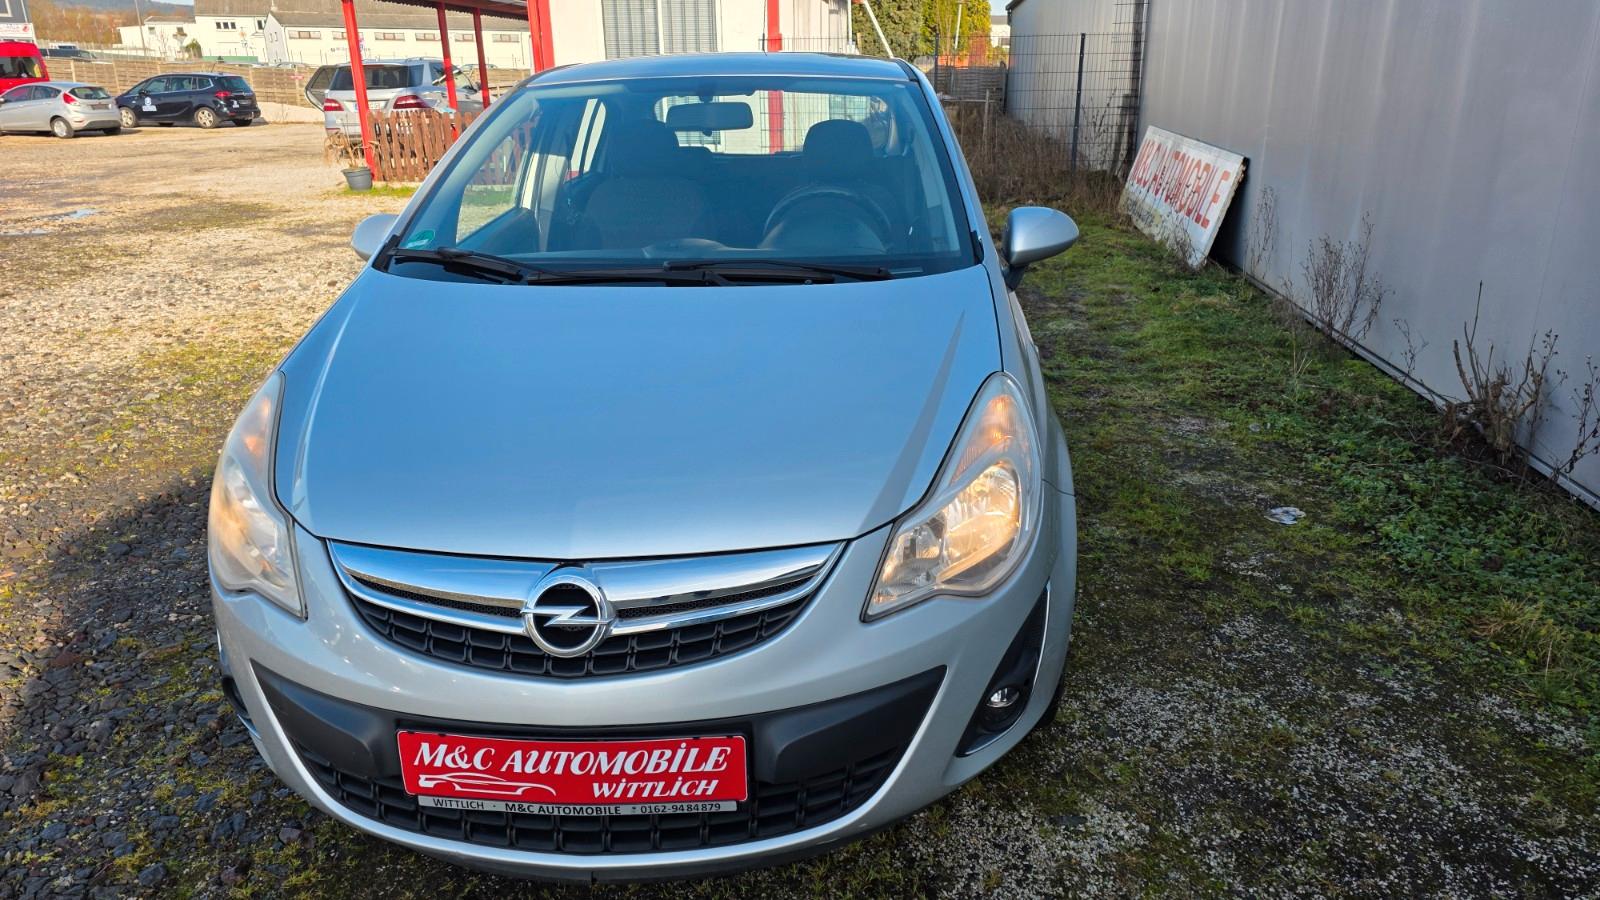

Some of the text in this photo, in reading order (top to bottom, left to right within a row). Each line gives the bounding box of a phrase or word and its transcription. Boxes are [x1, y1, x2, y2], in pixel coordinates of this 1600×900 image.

[1149, 144, 1231, 229] AUTOMOBILE
[414, 742, 496, 770] M&C
[432, 799, 485, 811] WITTLICH
[505, 803, 535, 814] M&C
[538, 805, 622, 816] AUTOMOBILE
